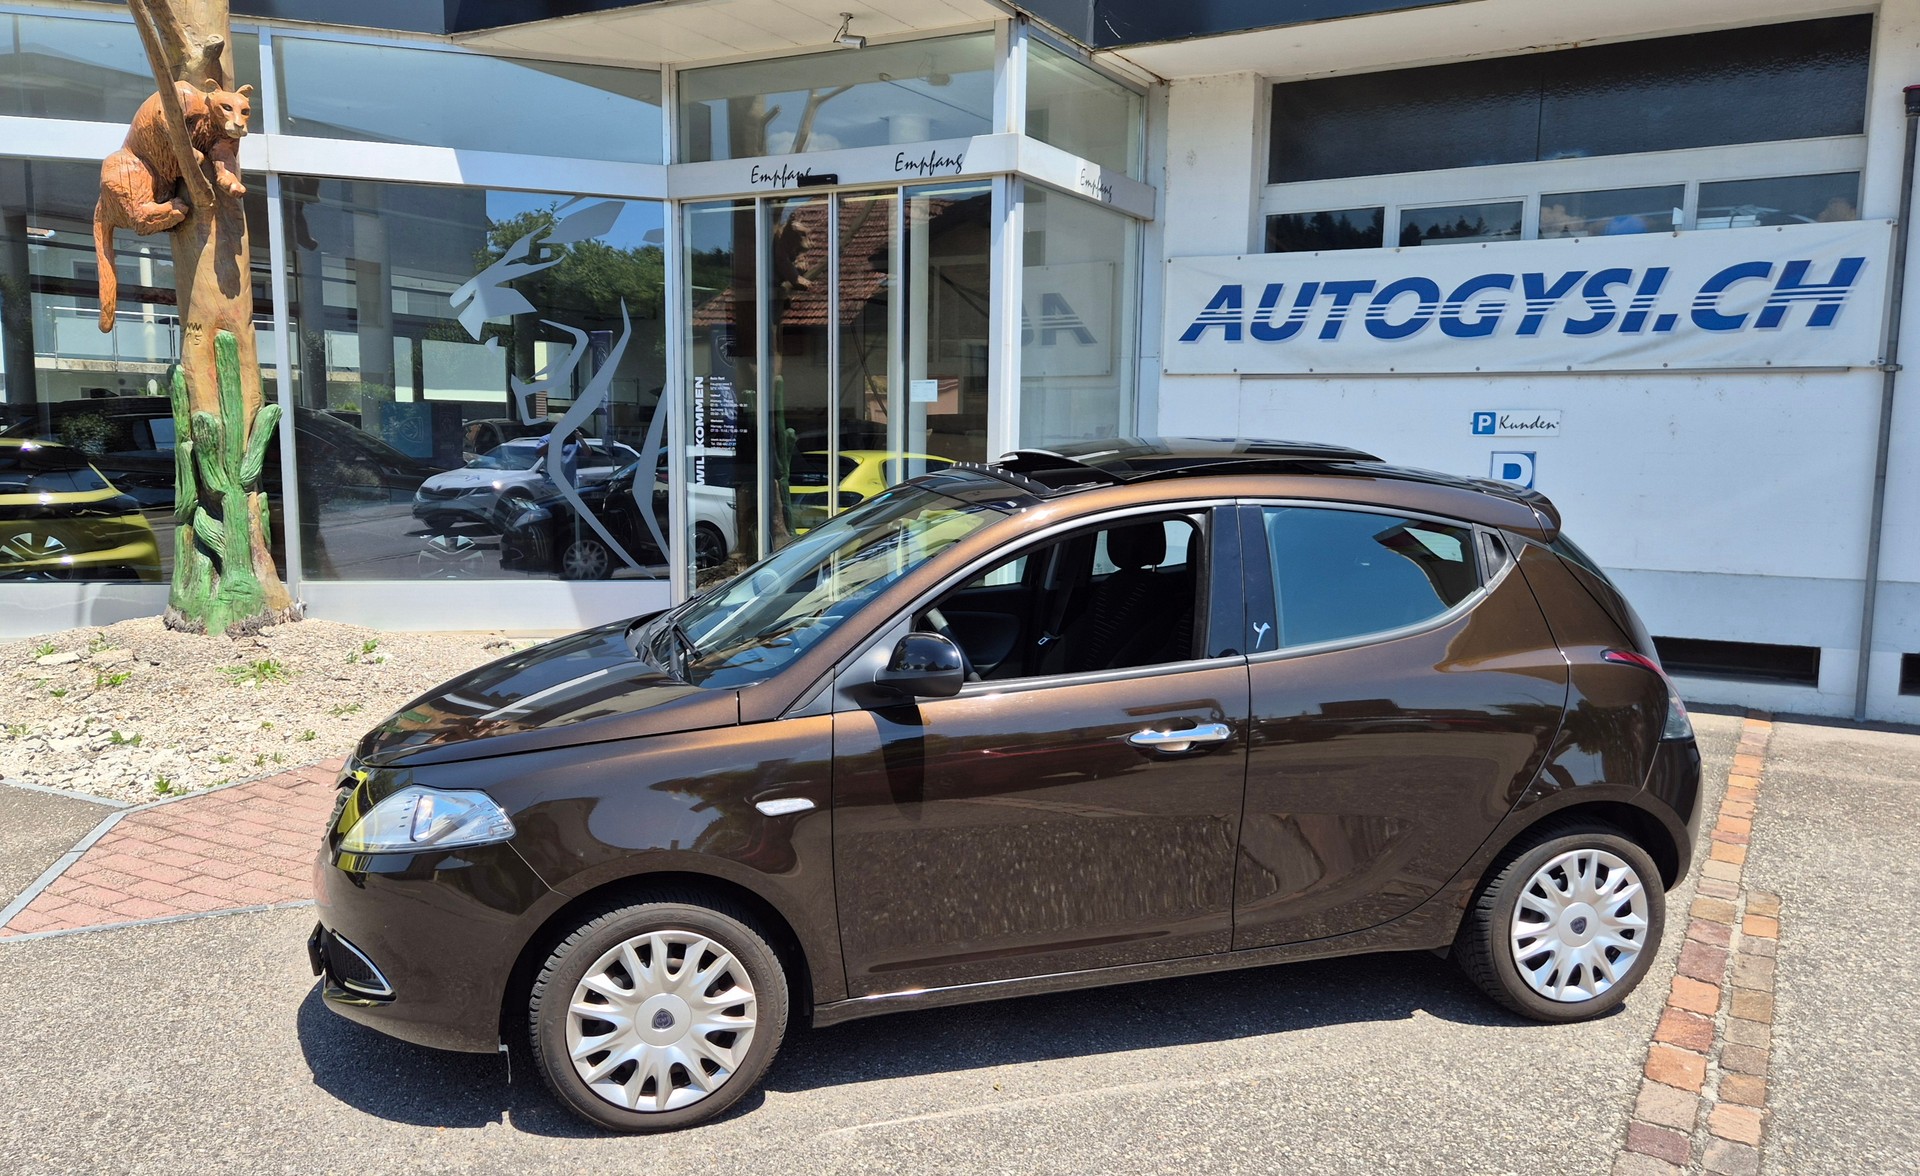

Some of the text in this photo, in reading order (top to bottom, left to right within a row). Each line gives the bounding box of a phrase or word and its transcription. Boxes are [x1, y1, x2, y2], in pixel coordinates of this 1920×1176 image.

[895, 150, 963, 176] Empfang
[1179, 256, 1866, 344] AUTOGYSI.CH
[695, 376, 705, 485] WILKOMMEN
[1477, 414, 1556, 432] P Kunden
